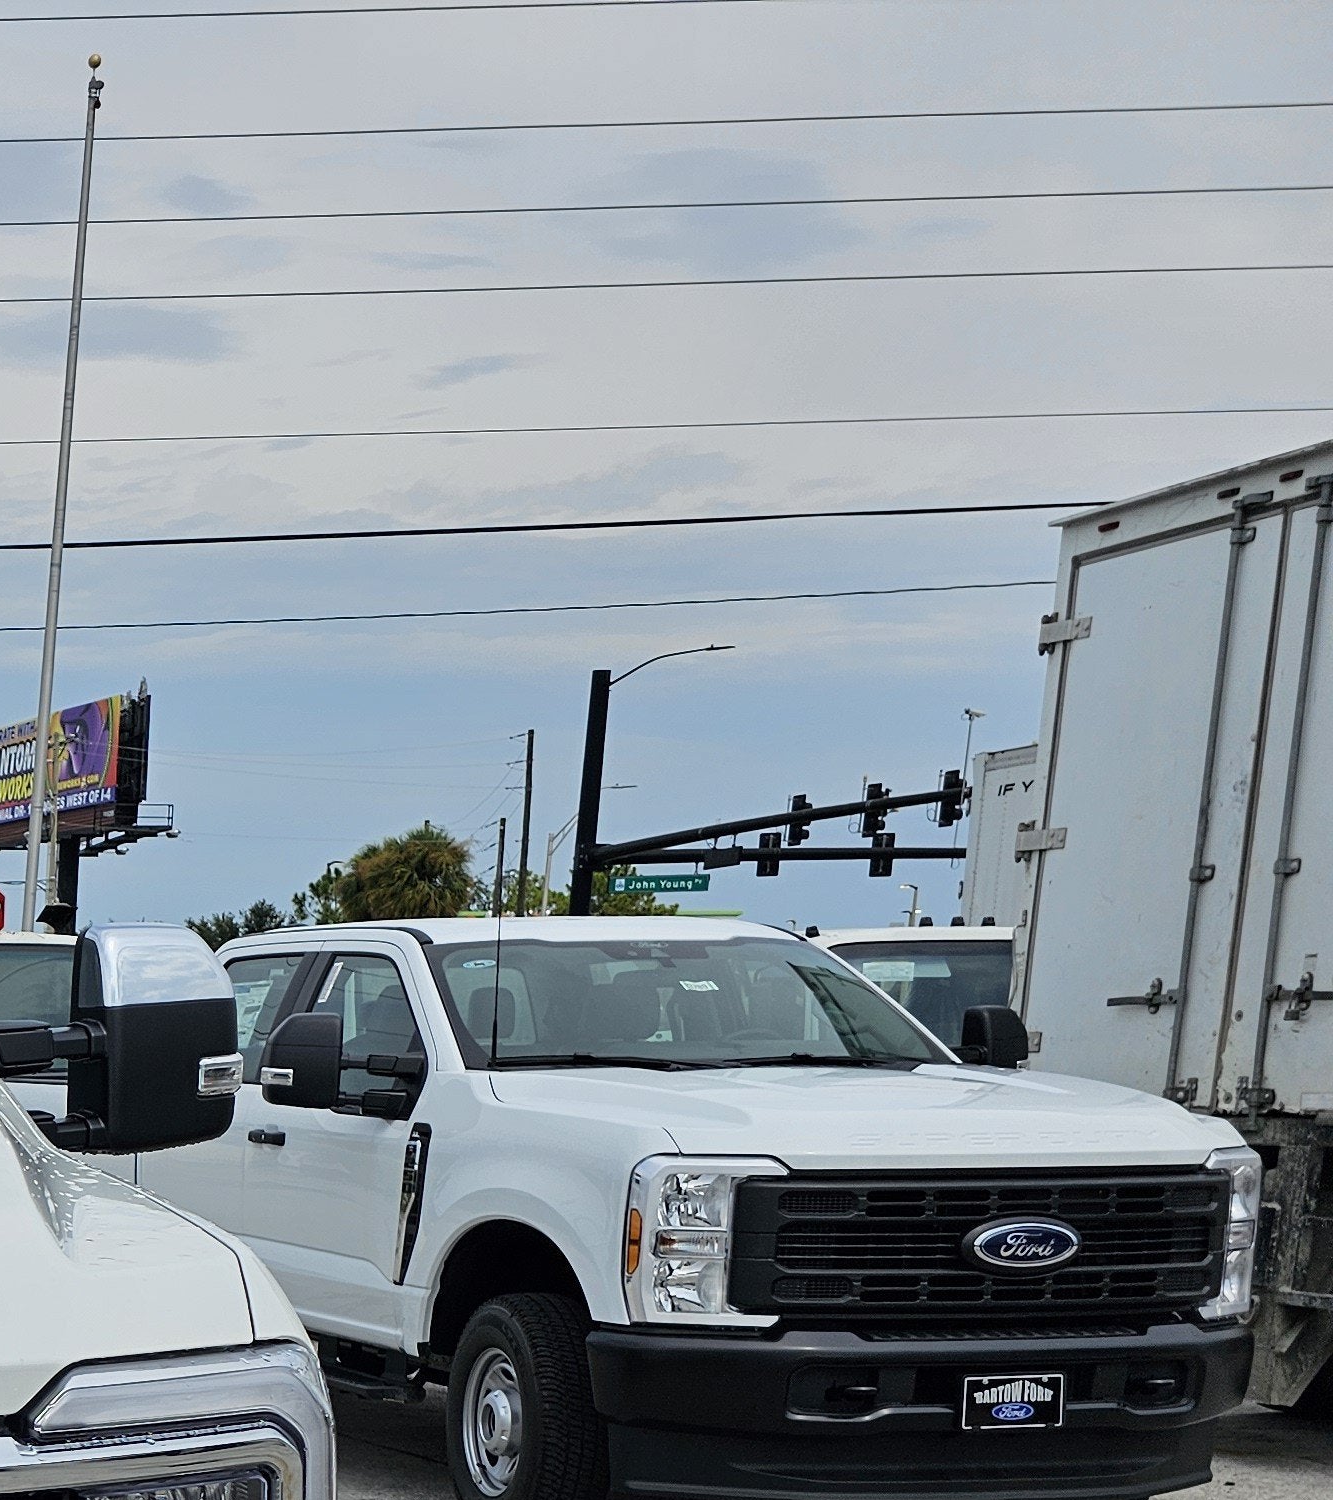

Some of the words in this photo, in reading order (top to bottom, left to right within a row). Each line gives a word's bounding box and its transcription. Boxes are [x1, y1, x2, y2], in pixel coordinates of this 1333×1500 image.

[998, 783, 1015, 796] IF
[1022, 780, 1034, 792] Y
[67, 793, 87, 808] WEST
[89, 789, 100, 804] OF
[101, 788, 112, 801] I-4
[629, 880, 656, 890] John
[659, 879, 693, 890] Young
[1000, 1232, 1054, 1257] Ford
[974, 1380, 1023, 1403] BARTOW
[1023, 1380, 1054, 1402] FORD
[999, 1405, 1027, 1418] Ford
